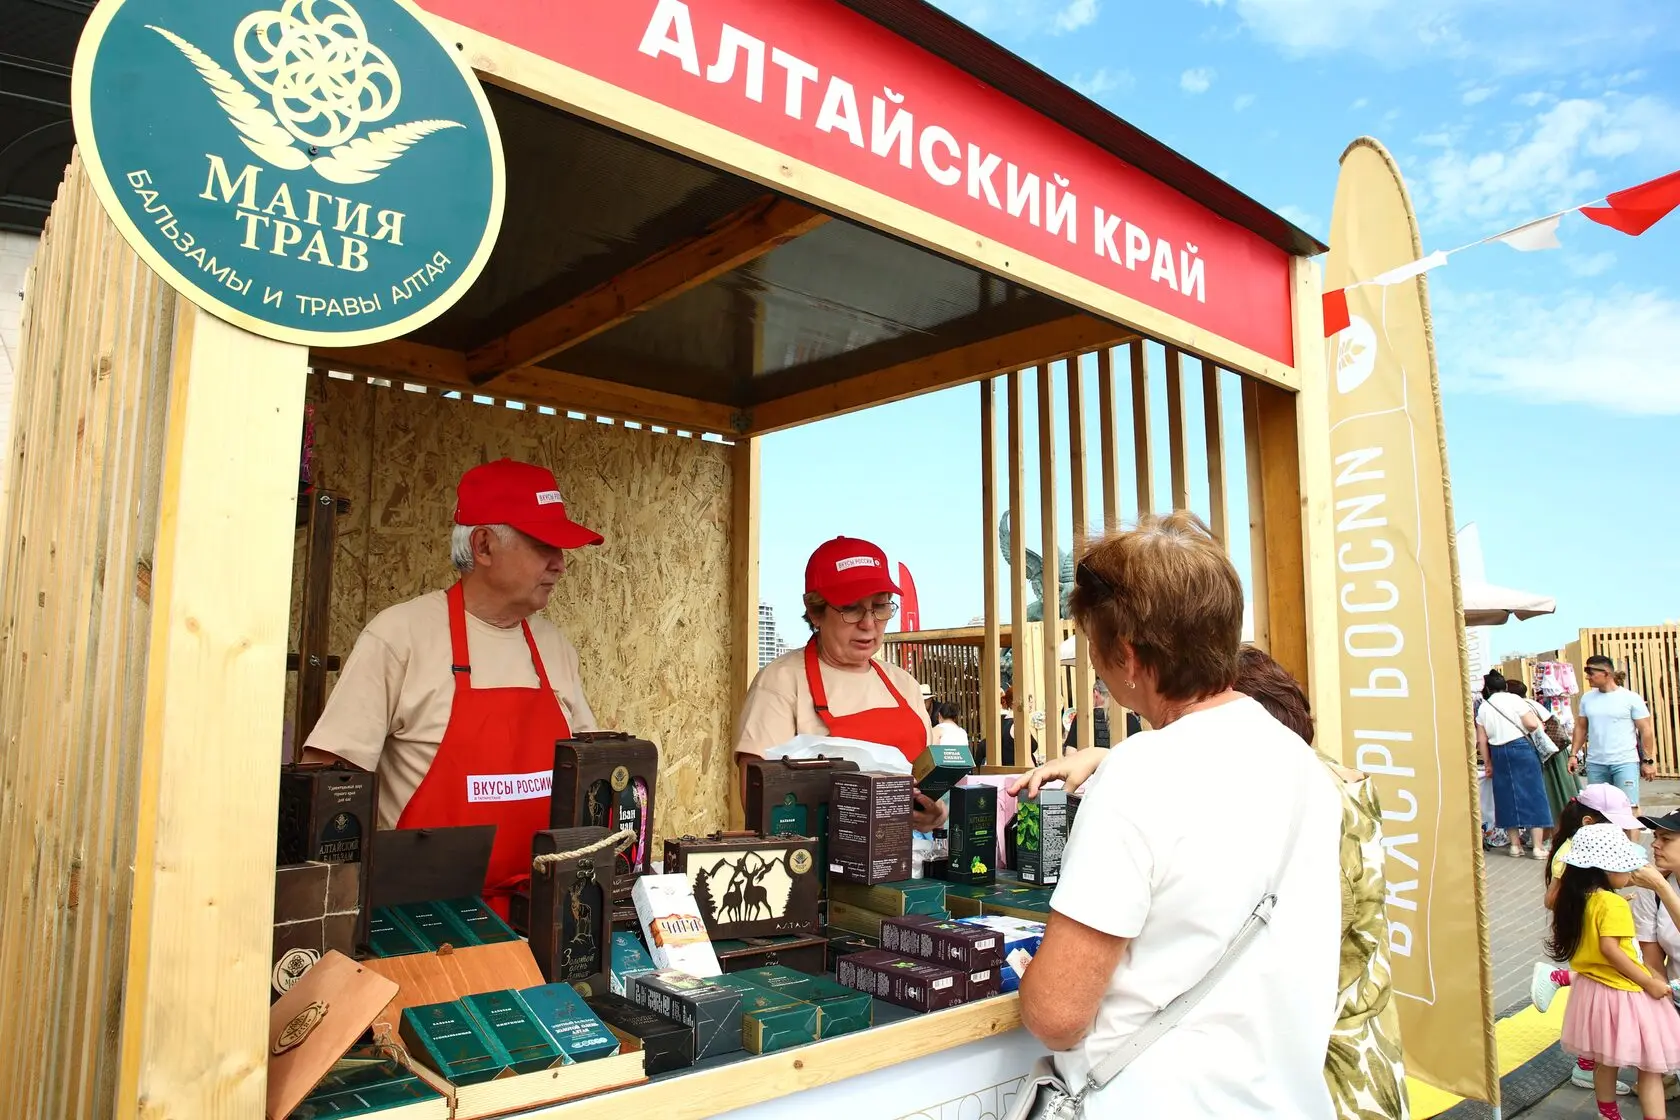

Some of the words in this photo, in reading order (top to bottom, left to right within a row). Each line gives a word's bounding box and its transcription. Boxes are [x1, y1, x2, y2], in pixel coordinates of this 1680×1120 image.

[638, 0, 1078, 244] АЛТАЙСКИЙ
[1093, 205, 1206, 304] КРАЙ
[199, 153, 406, 246] МАГИЯ
[127, 169, 251, 296] БАЛЬЗАМЫ
[263, 286, 282, 309] И
[296, 293, 382, 317] ТРАВЫ
[391, 251, 452, 305] АЛТАЯ
[235, 209, 370, 273] ТРАВ
[473, 780, 513, 795] ВКУСЫ
[517, 776, 552, 794] РОССИИ
[662, 919, 701, 934] ЧАГА
